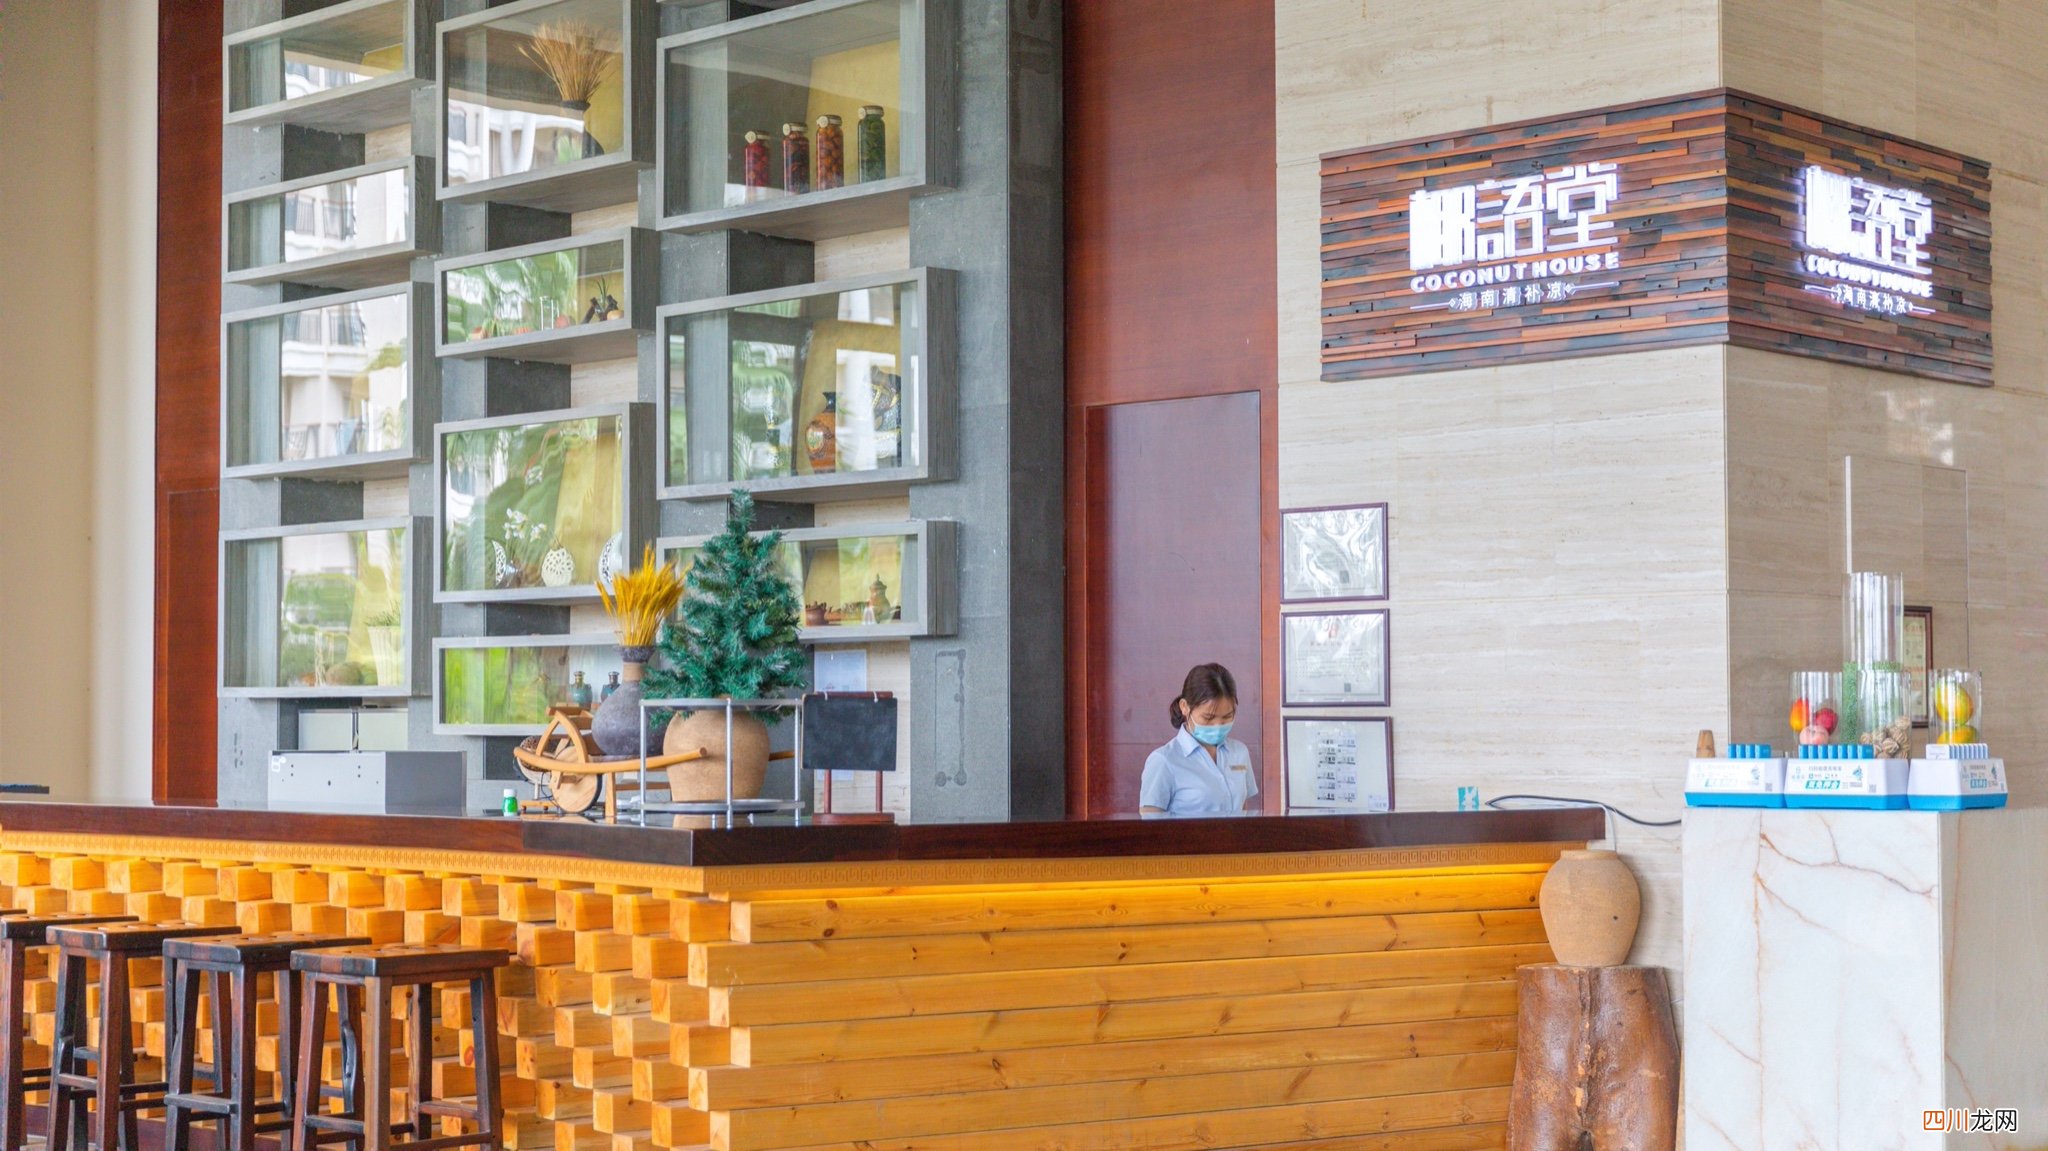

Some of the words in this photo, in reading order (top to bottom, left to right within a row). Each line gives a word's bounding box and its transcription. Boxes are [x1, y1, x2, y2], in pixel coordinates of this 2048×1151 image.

[1458, 281, 1564, 310] 海南清补凉
